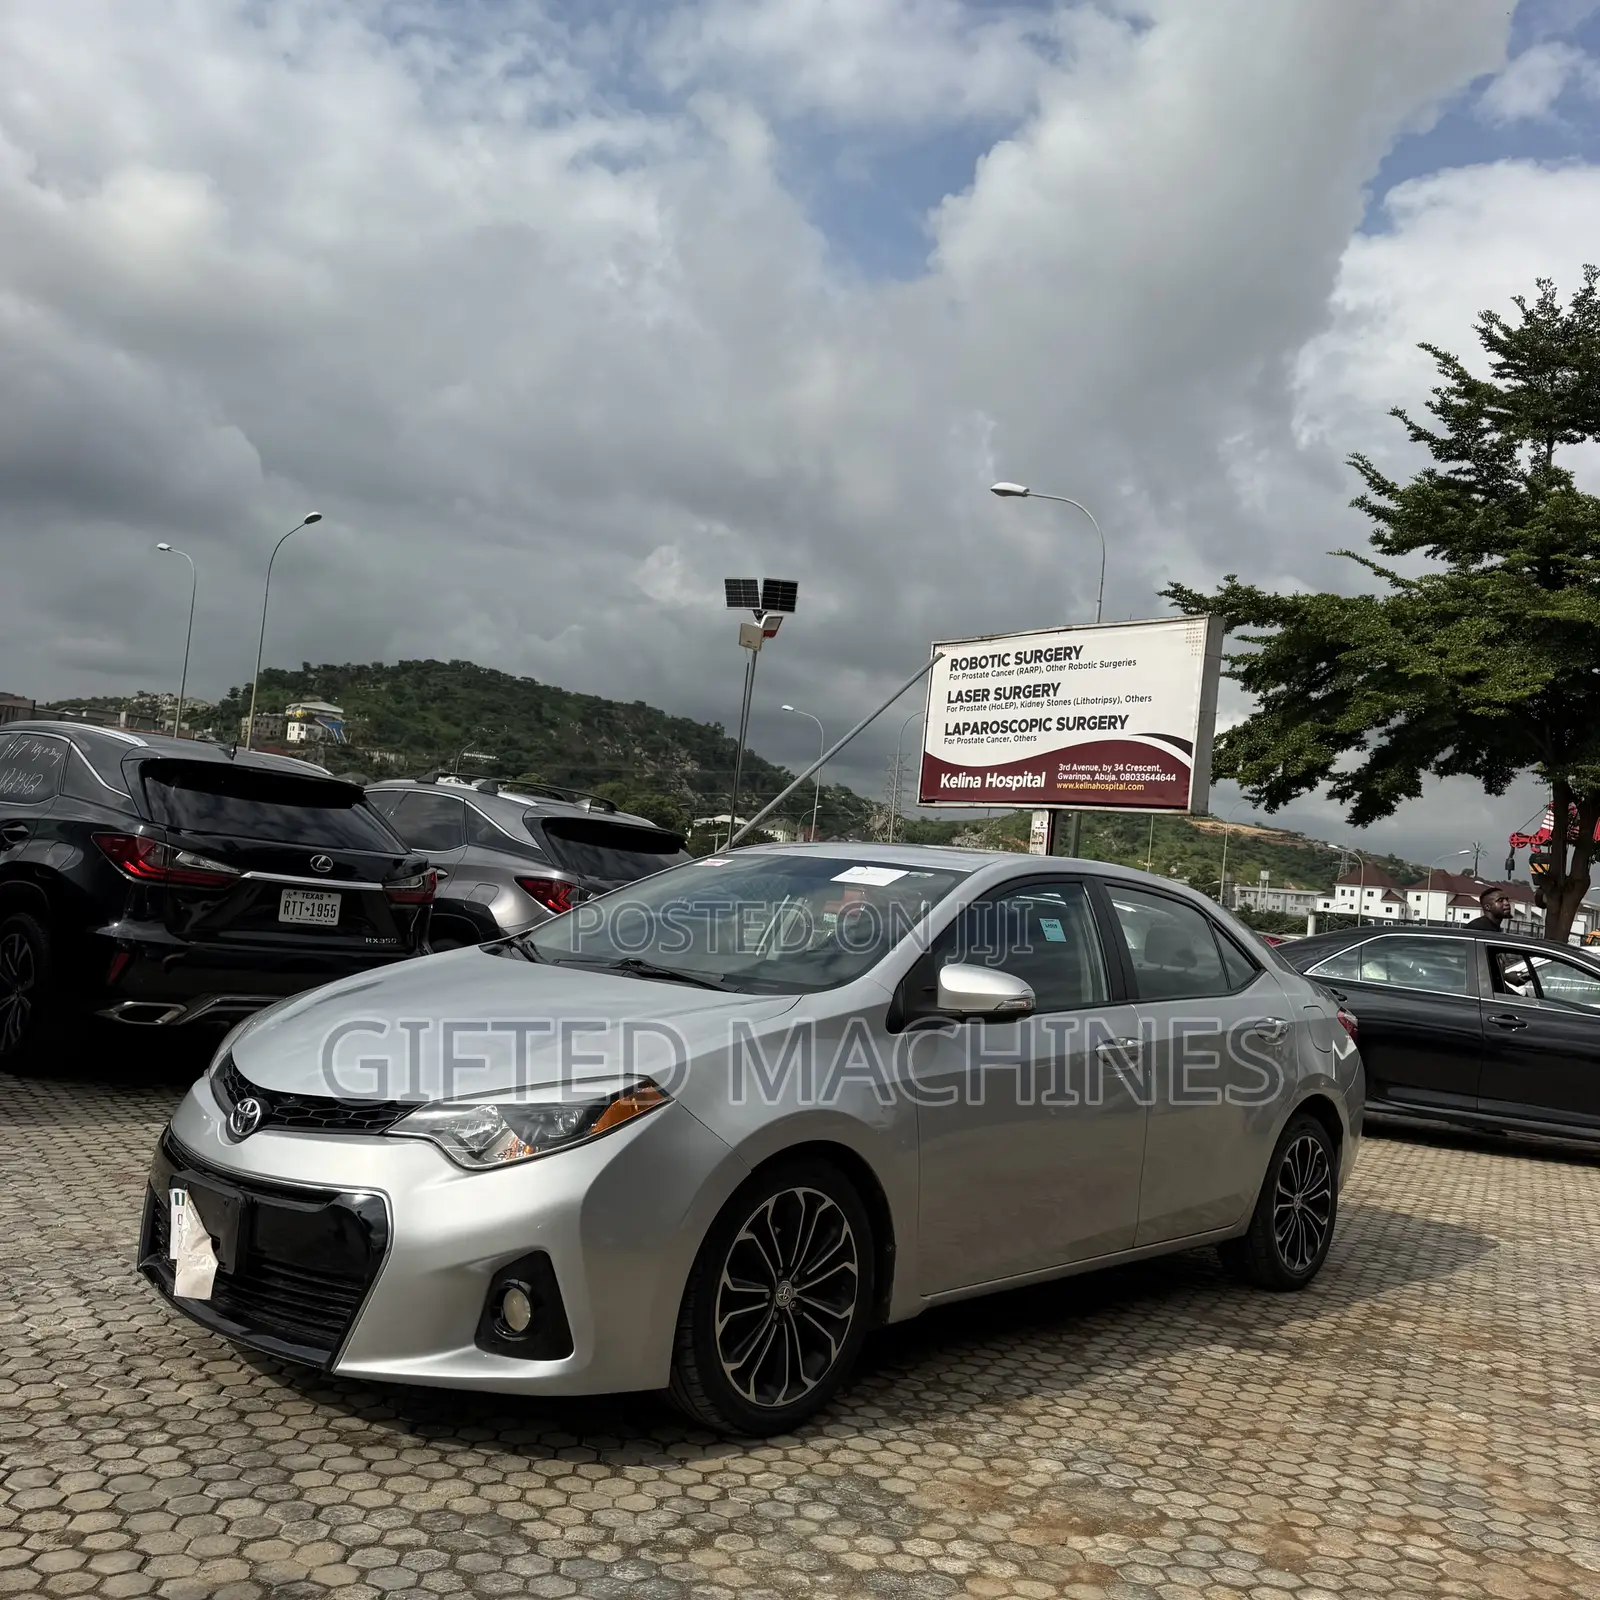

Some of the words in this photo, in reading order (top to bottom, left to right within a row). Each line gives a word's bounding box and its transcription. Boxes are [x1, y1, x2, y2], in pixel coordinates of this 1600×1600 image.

[950, 653, 1011, 671] ROBOTIC
[1014, 645, 1083, 666] SURGERY
[961, 671, 989, 680] Prostate
[991, 669, 1015, 678] Cancer
[1016, 666, 1044, 676] (RARP),
[1045, 663, 1066, 672] Other
[1068, 661, 1097, 670] Robotic
[1099, 658, 1137, 669] Surgeries
[947, 688, 990, 704] LASER
[993, 682, 1061, 701] SURGERY
[946, 705, 957, 713] For
[959, 704, 987, 712] Prostate
[988, 702, 1019, 711] (HoLEP),
[1020, 700, 1045, 709] Kidney
[1047, 698, 1071, 707] Stones
[1073, 695, 1123, 707] (Lithotripsy),
[1125, 694, 1152, 703] Others
[945, 717, 1053, 736] LAPAROSCOPIC
[1056, 714, 1129, 732] SURGERY
[956, 736, 984, 744] Prostate
[1013, 734, 1037, 742] Others
[1058, 763, 1071, 771] 3rd
[1072, 763, 1101, 772] Avenue,
[1102, 764, 1111, 773] by
[1113, 763, 1123, 772] 34
[1125, 763, 1162, 773] Crescent,
[1120, 773, 1176, 782] 08033644644
[940, 771, 981, 789] Kelina
[985, 770, 1046, 791] Hospital
[1056, 781, 1145, 791] www.kelinahospital.com
[301, 892, 324, 900] TEXAS
